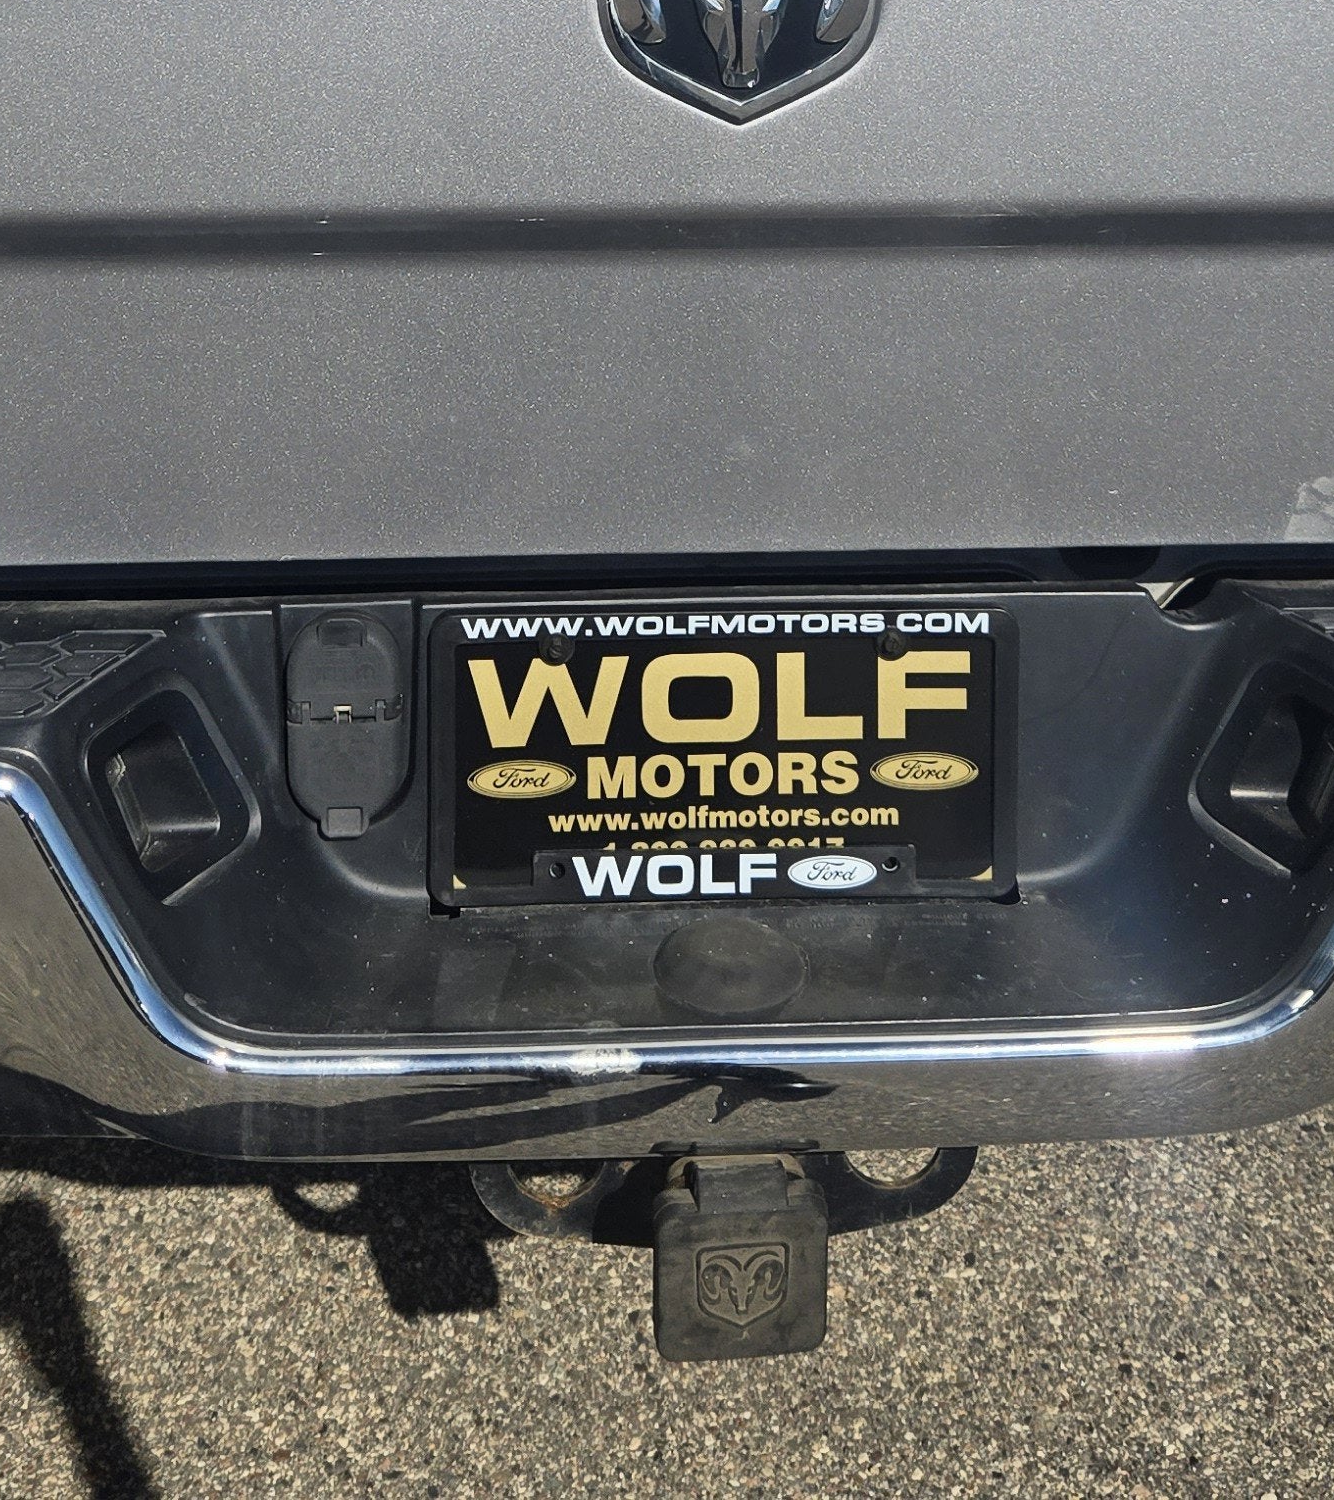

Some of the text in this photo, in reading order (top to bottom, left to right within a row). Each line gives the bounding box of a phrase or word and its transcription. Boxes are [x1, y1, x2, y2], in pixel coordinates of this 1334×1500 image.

[461, 613, 990, 639] WWW.WOLFMOTORSCOM
[467, 651, 971, 748] WOLF
[494, 768, 551, 790] Ford
[587, 751, 859, 799] MOTORS
[896, 760, 953, 782] Ford
[548, 805, 900, 832] www.wolfmotors.com
[572, 853, 777, 896] WOLF
[807, 861, 858, 882] Ford
